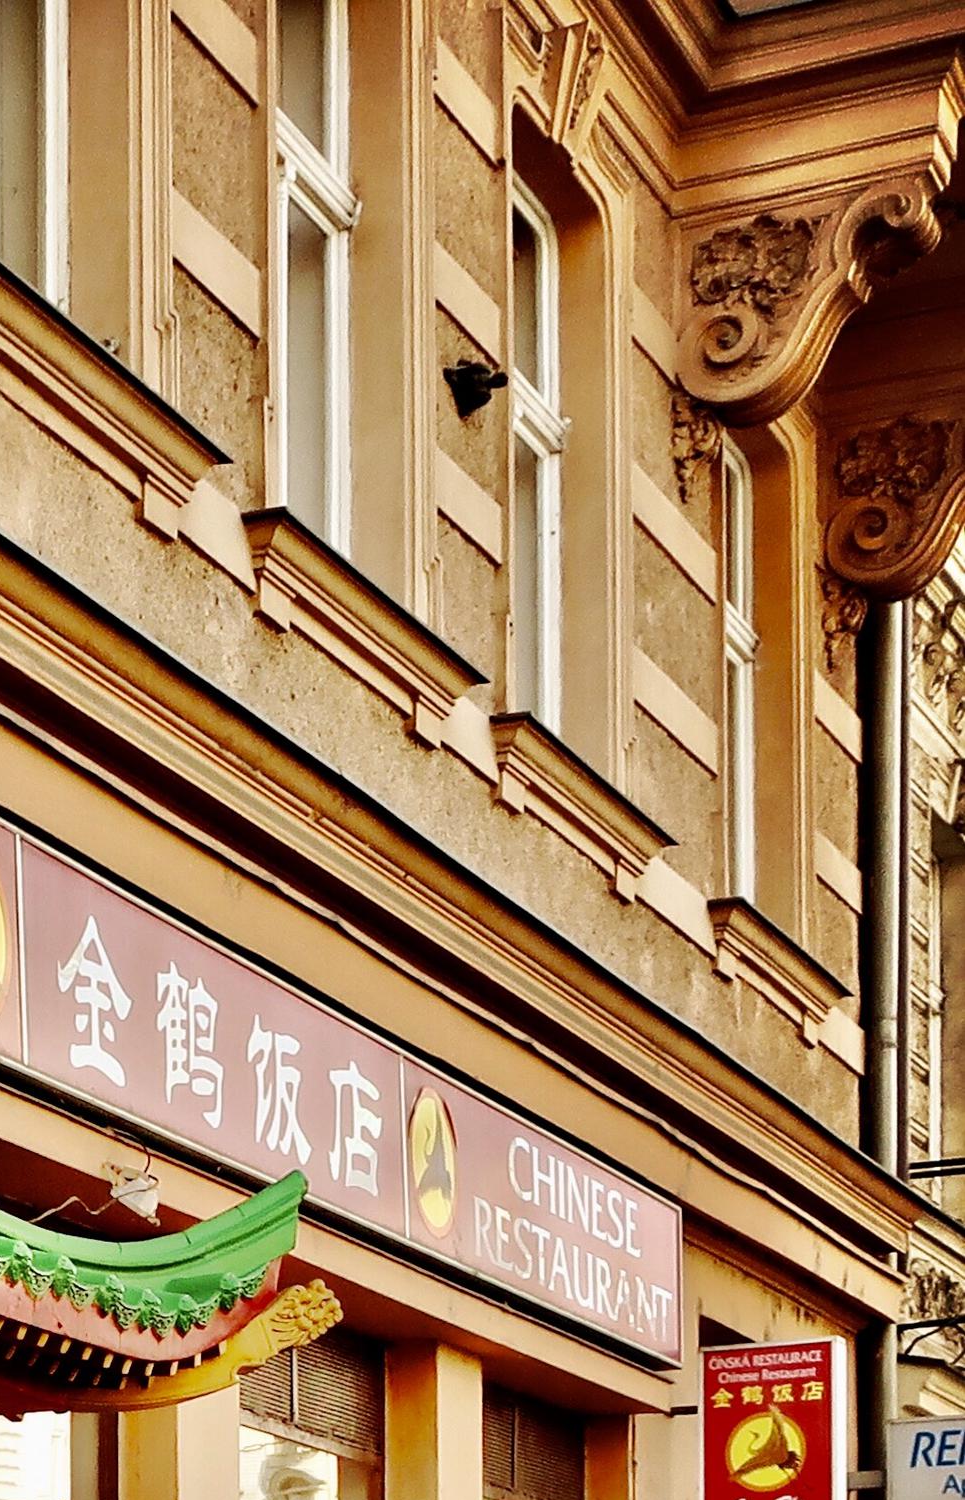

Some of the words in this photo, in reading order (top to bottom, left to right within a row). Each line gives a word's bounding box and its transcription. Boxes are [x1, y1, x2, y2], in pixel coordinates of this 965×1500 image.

[508, 1136, 642, 1258] CHINESE
[473, 1195, 674, 1342] RESTAURANT
[717, 1371, 760, 1384] Chinese
[761, 1366, 817, 1380] Restaurant
[752, 1349, 823, 1367] RESTAURACE
